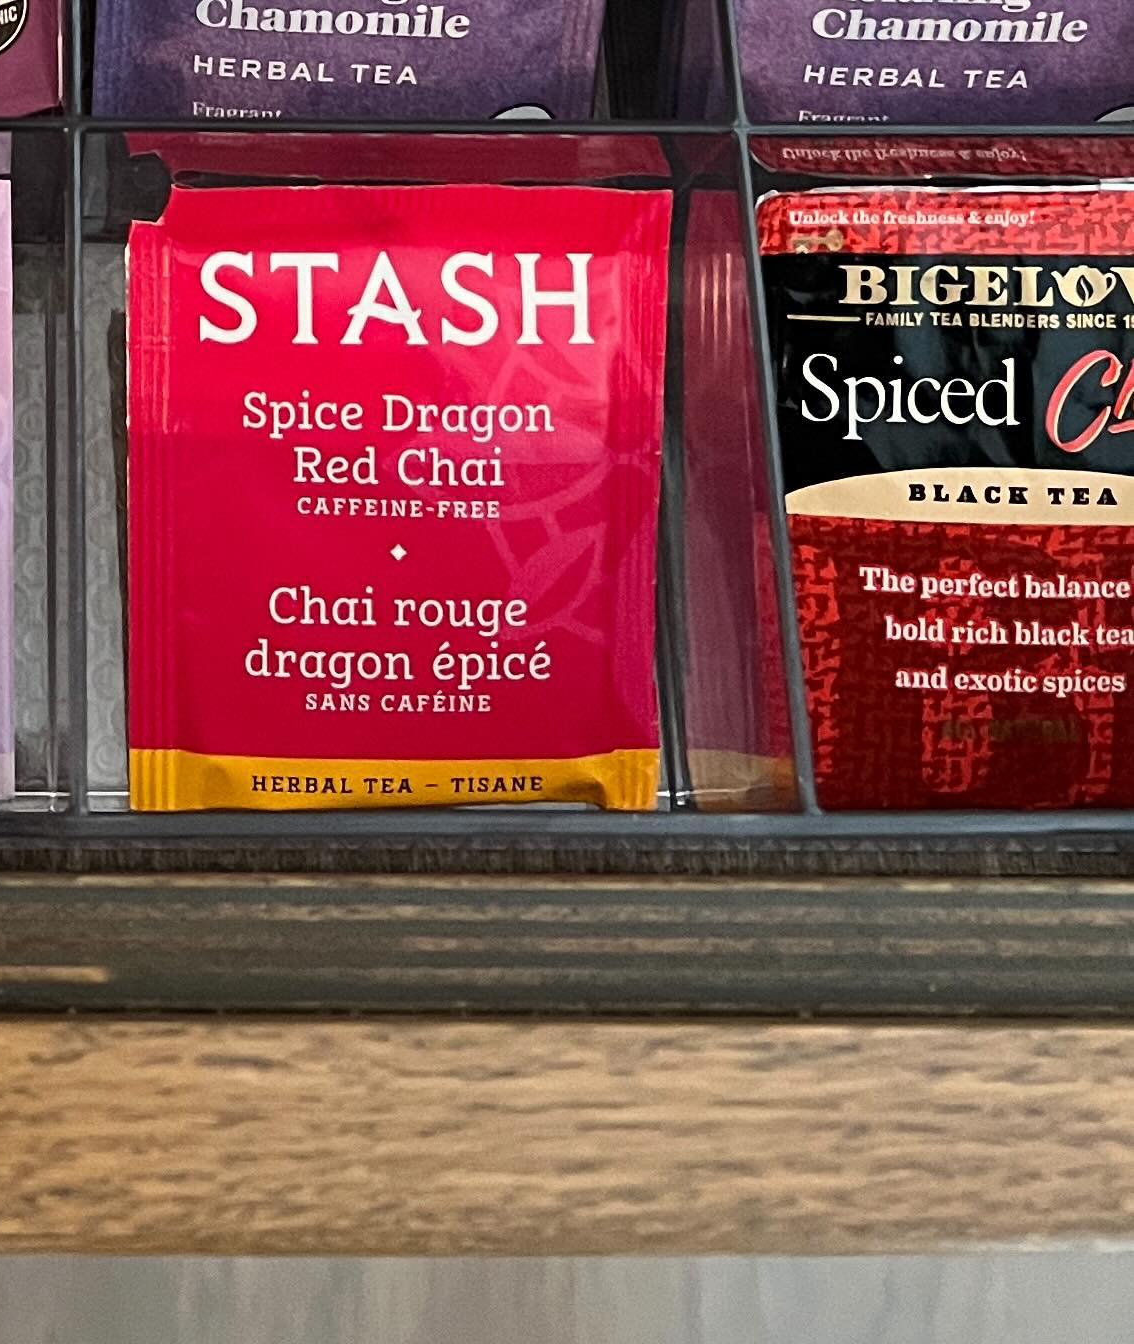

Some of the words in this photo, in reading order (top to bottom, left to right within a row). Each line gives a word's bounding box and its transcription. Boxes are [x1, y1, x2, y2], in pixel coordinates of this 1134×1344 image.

[811, 8, 1088, 43] Chamomile
[193, 55, 334, 82] HERBAL
[350, 64, 418, 86] TEA
[198, 251, 595, 346] STASH
[801, 354, 1020, 441] Spiced
[243, 390, 364, 438] Spice
[382, 394, 555, 442] Dragon
[293, 446, 378, 485] Red
[398, 447, 505, 487] Chai
[297, 497, 500, 520] CAFFEINE-FREE
[908, 484, 1029, 505] BLACK
[1048, 488, 1118, 506] TEA
[859, 567, 917, 595] The
[921, 572, 1019, 600] perfect
[1024, 575, 1130, 599] balance
[269, 586, 375, 627] Chai
[394, 595, 527, 636] rouge
[244, 639, 413, 688] dragon
[432, 641, 551, 689] épicé
[895, 668, 949, 690] and
[954, 667, 1038, 694] exotic
[1043, 667, 1126, 694] spices
[305, 694, 371, 712] SANS
[380, 691, 491, 714] CAFÉINE
[251, 775, 353, 794] HERBAL
[364, 777, 413, 794] TEA
[451, 775, 543, 793] TISANE
